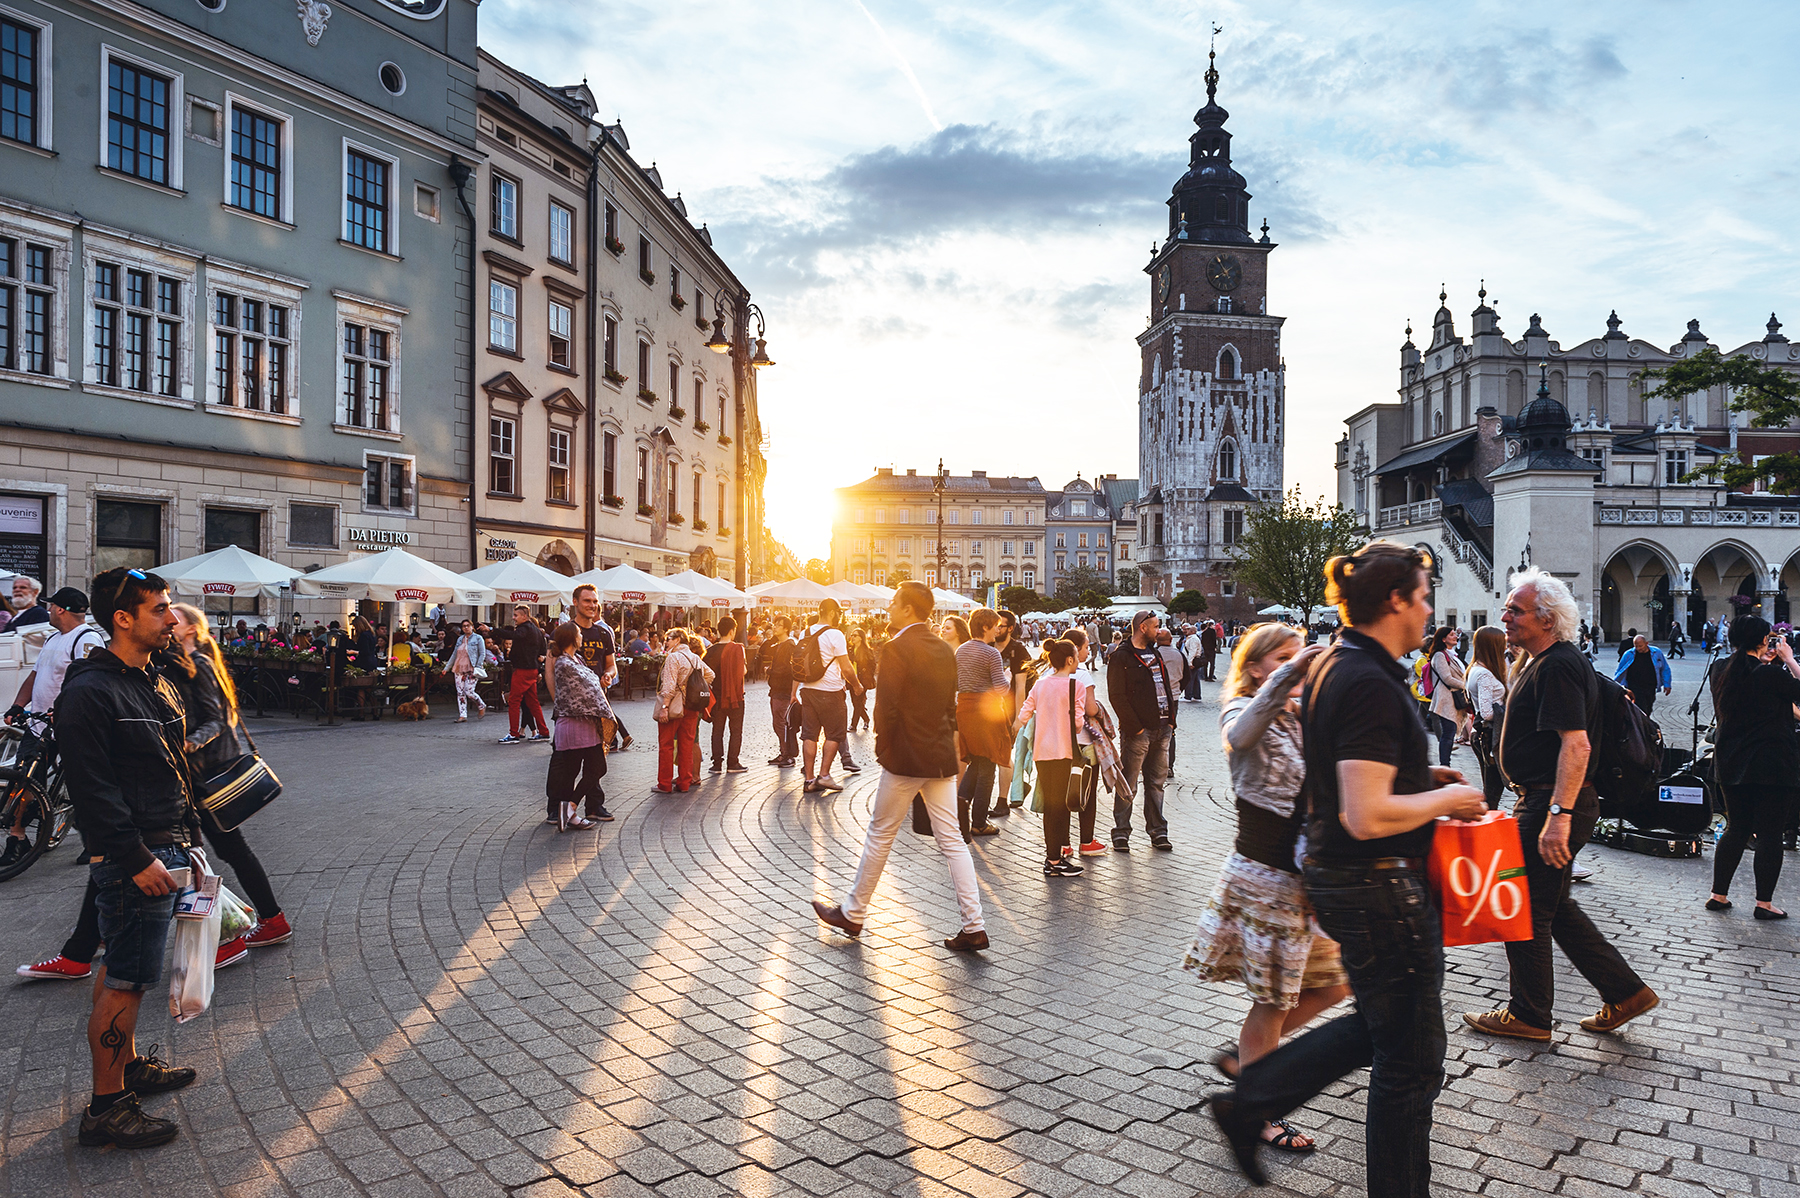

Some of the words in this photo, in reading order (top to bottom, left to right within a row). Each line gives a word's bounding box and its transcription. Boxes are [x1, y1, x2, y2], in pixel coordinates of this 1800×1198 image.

[0, 508, 38, 518] uvenirs
[349, 528, 367, 541] DA
[369, 529, 410, 544] PIETRO
[357, 543, 402, 551] restauraa
[489, 537, 517, 549] CRACOW
[1449, 849, 1523, 927] %
